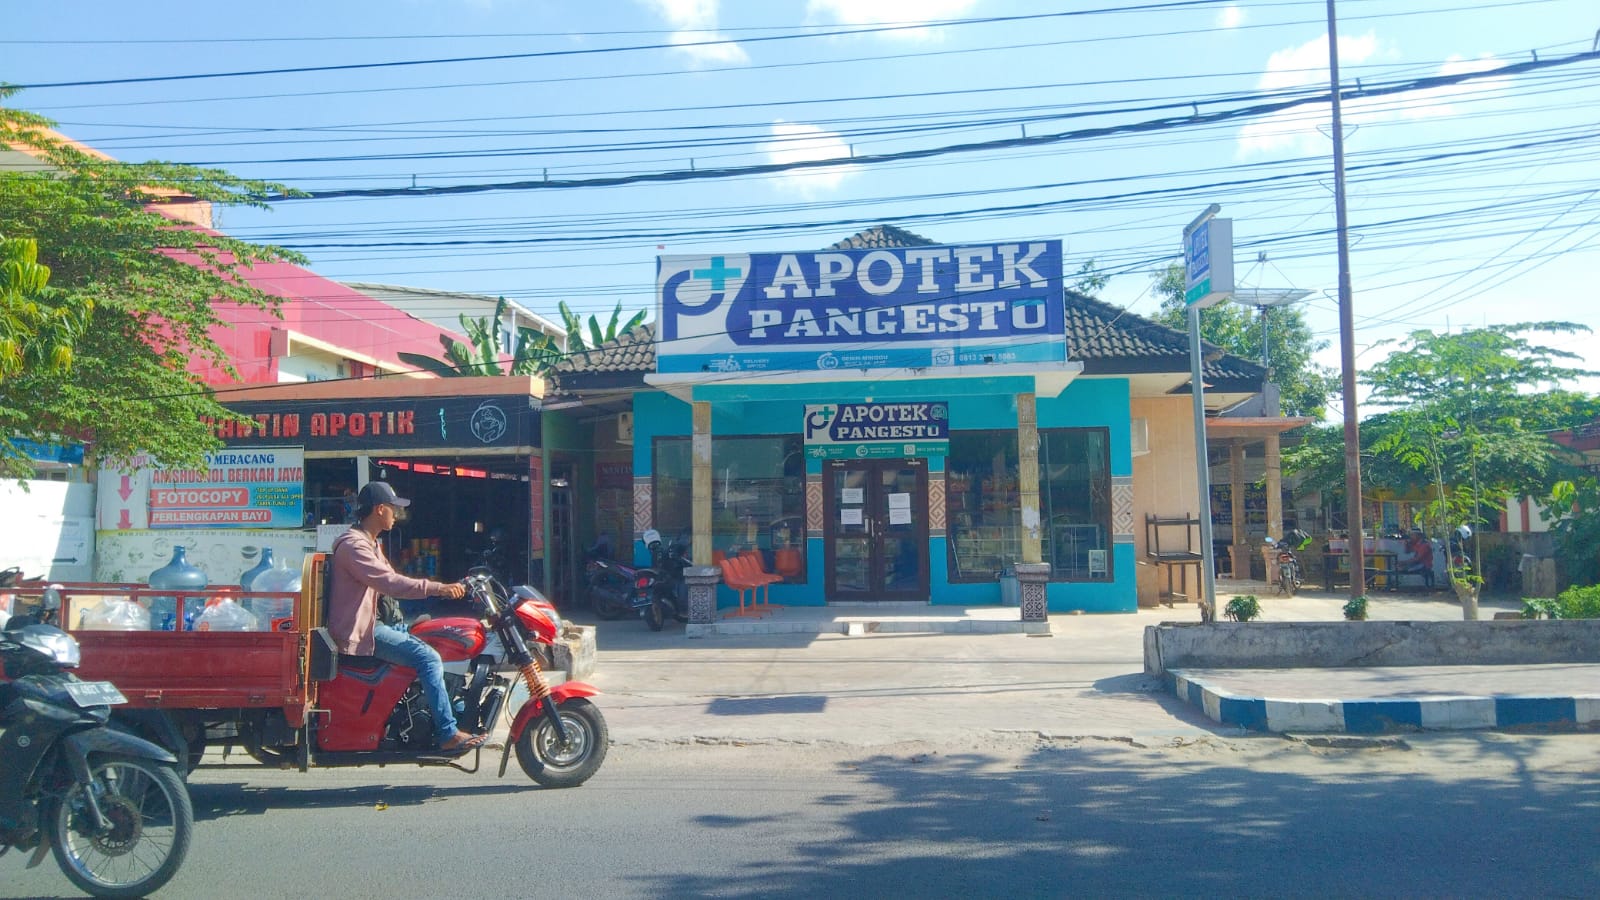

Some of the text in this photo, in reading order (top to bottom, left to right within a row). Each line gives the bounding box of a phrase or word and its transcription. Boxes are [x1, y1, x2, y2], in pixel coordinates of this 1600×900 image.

[762, 242, 1049, 299] APOTEK
[748, 298, 1048, 339] PANGESTU
[840, 404, 928, 422] APOTEK
[310, 410, 415, 437] APOTIK
[836, 425, 940, 439] PANGESTU
[213, 454, 275, 465] MERACANG
[227, 467, 275, 482] BERKAH
[277, 466, 304, 482] JAYA
[157, 490, 243, 504] FOTOCOPY
[152, 510, 268, 522] PERLENGKAPAN BAYI
